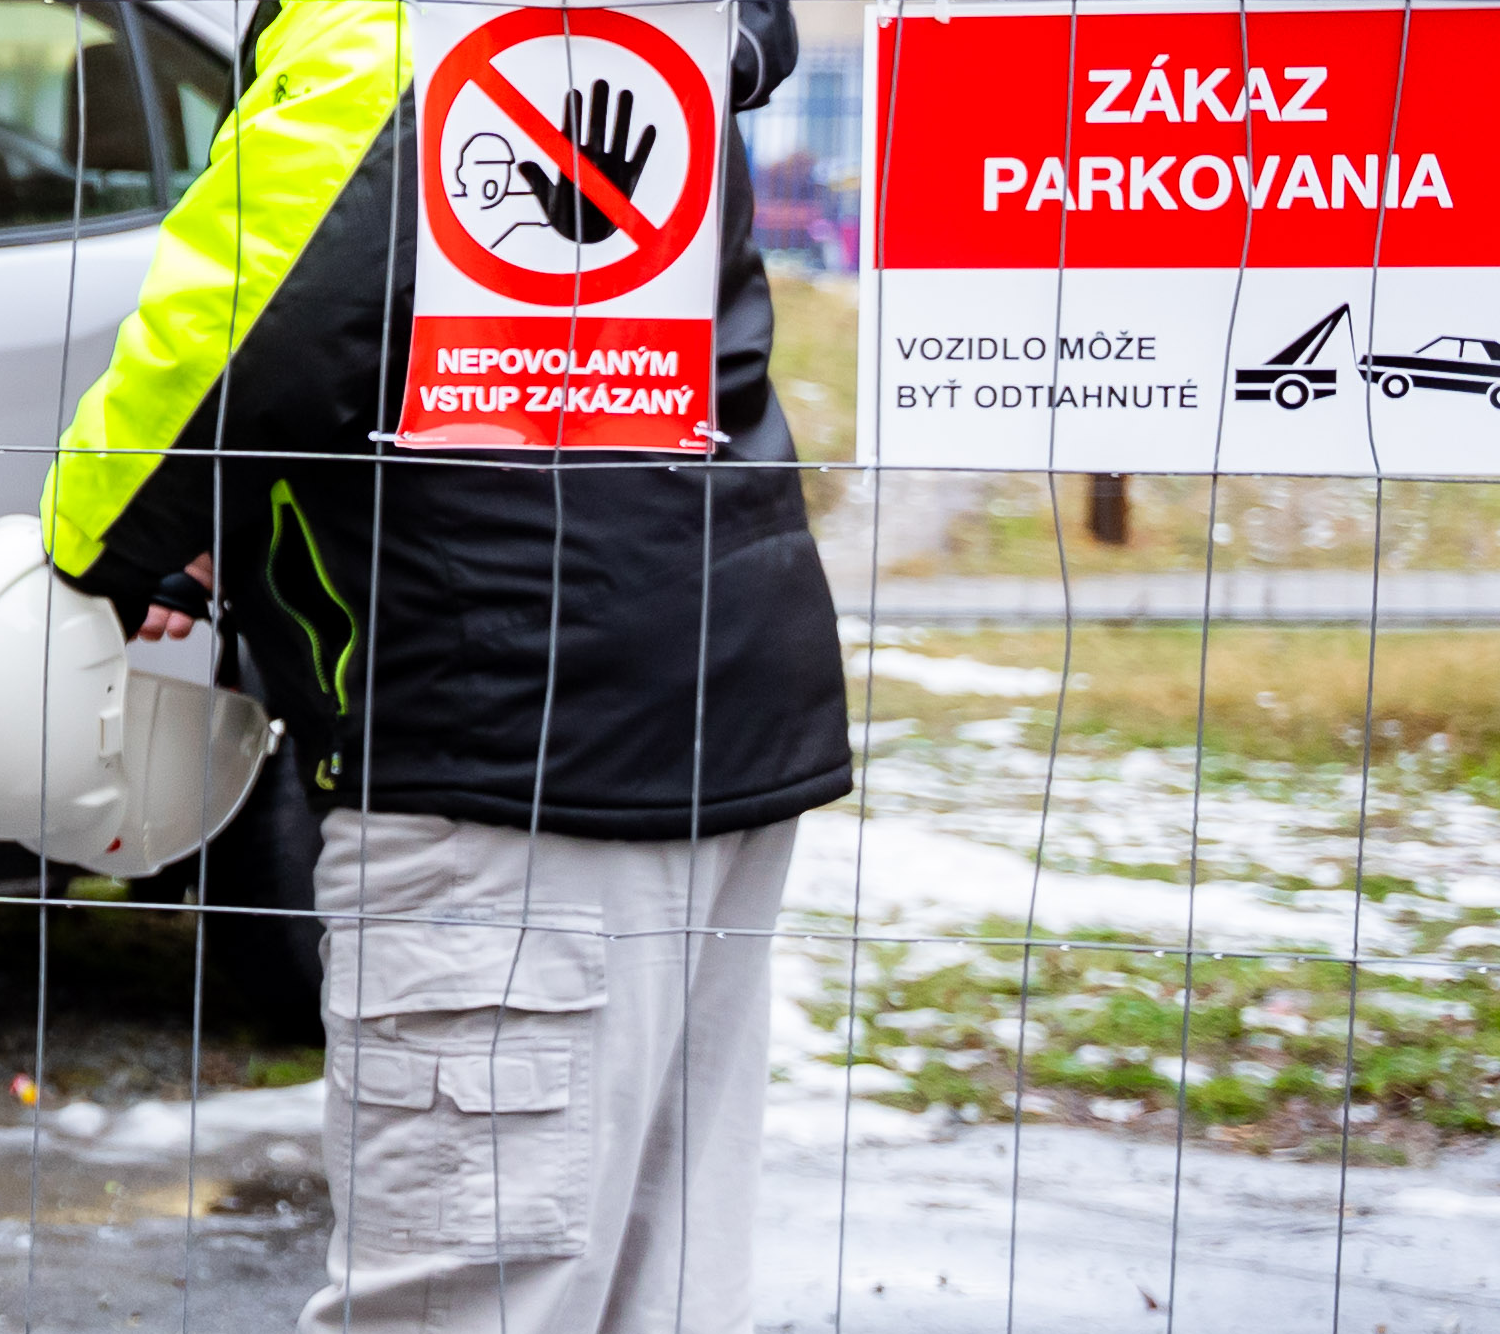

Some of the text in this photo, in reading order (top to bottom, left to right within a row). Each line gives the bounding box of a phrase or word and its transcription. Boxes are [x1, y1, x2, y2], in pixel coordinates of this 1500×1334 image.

[1085, 54, 1328, 124] ZÁKAZ
[983, 153, 1454, 211] PARKOVANIA
[437, 345, 678, 377] NEPOVOLANÝM
[897, 330, 1157, 362] VOZIDLO MÔŽE
[419, 383, 694, 416] VSTUP ZAKÁZANÝ
[896, 378, 1199, 409] BYŤ ODTIAHNUTÉ
